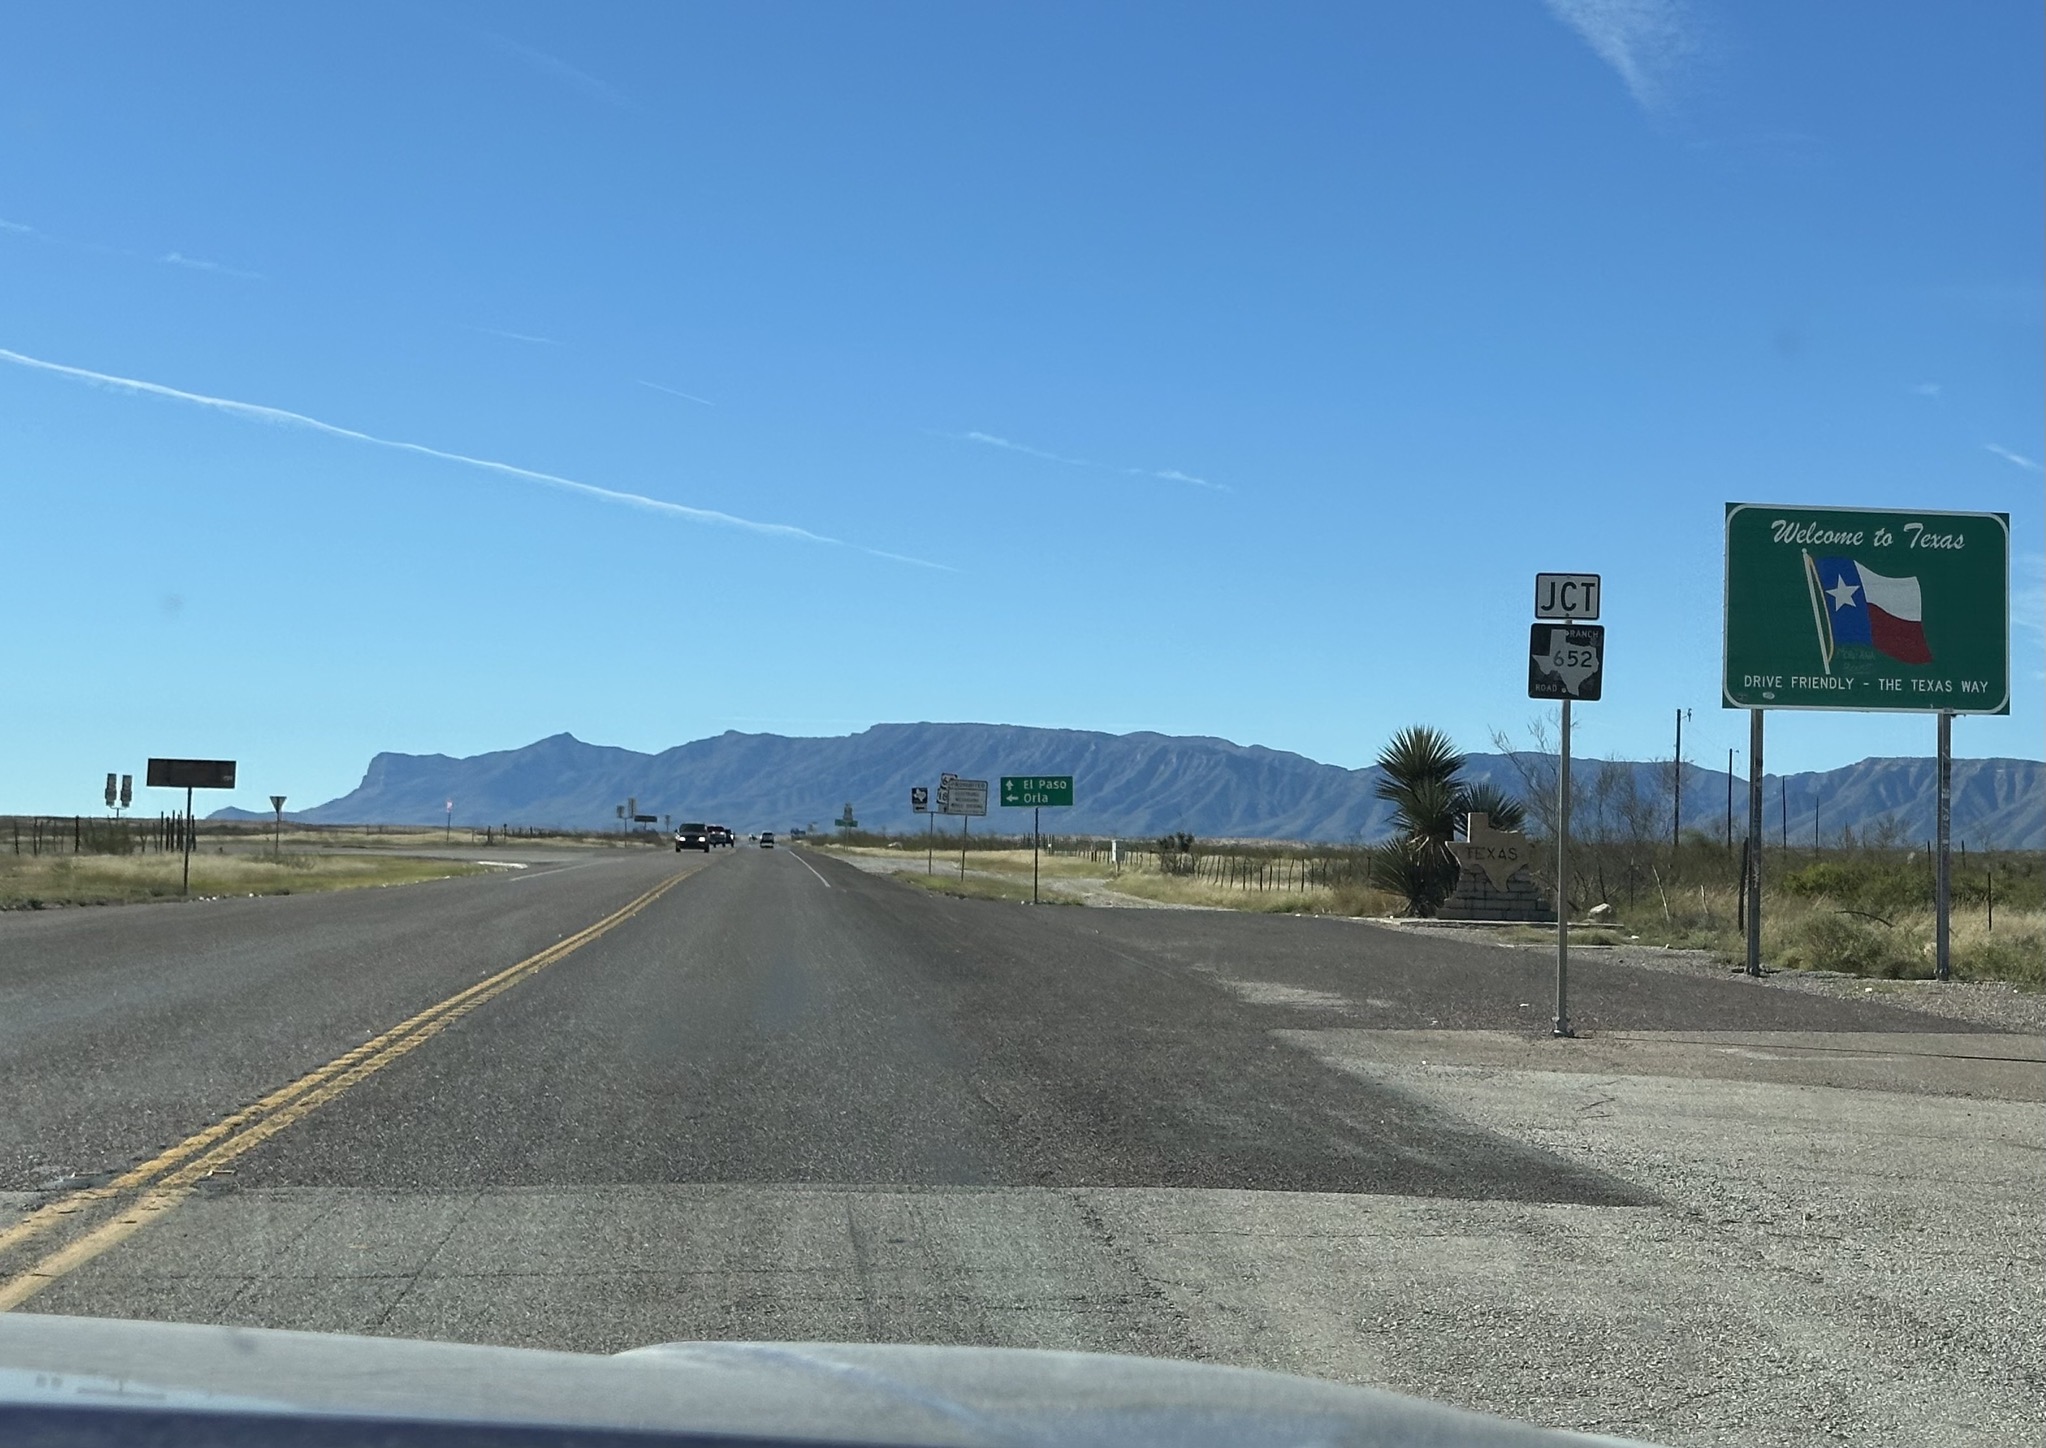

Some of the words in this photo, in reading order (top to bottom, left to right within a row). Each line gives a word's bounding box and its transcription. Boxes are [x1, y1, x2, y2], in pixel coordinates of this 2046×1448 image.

[1771, 519, 1864, 546] Welcome
[1873, 528, 1893, 547] to
[1903, 522, 1965, 549] Texas
[1541, 581, 1595, 611] JCT
[1570, 629, 1599, 638] RANCH
[1553, 650, 1592, 668] 652
[1535, 684, 1558, 692] ROAD
[1744, 675, 1783, 688] DRIVE
[1791, 676, 1854, 690] FRIENDLY
[1879, 678, 1902, 691] THE
[1911, 679, 1952, 692] TEXAS
[1961, 680, 1988, 693] WAY
[1023, 779, 1033, 789] El
[1039, 779, 1067, 790] Paso
[1023, 792, 1049, 803] Orla
[1466, 847, 1518, 860] TEXAS
